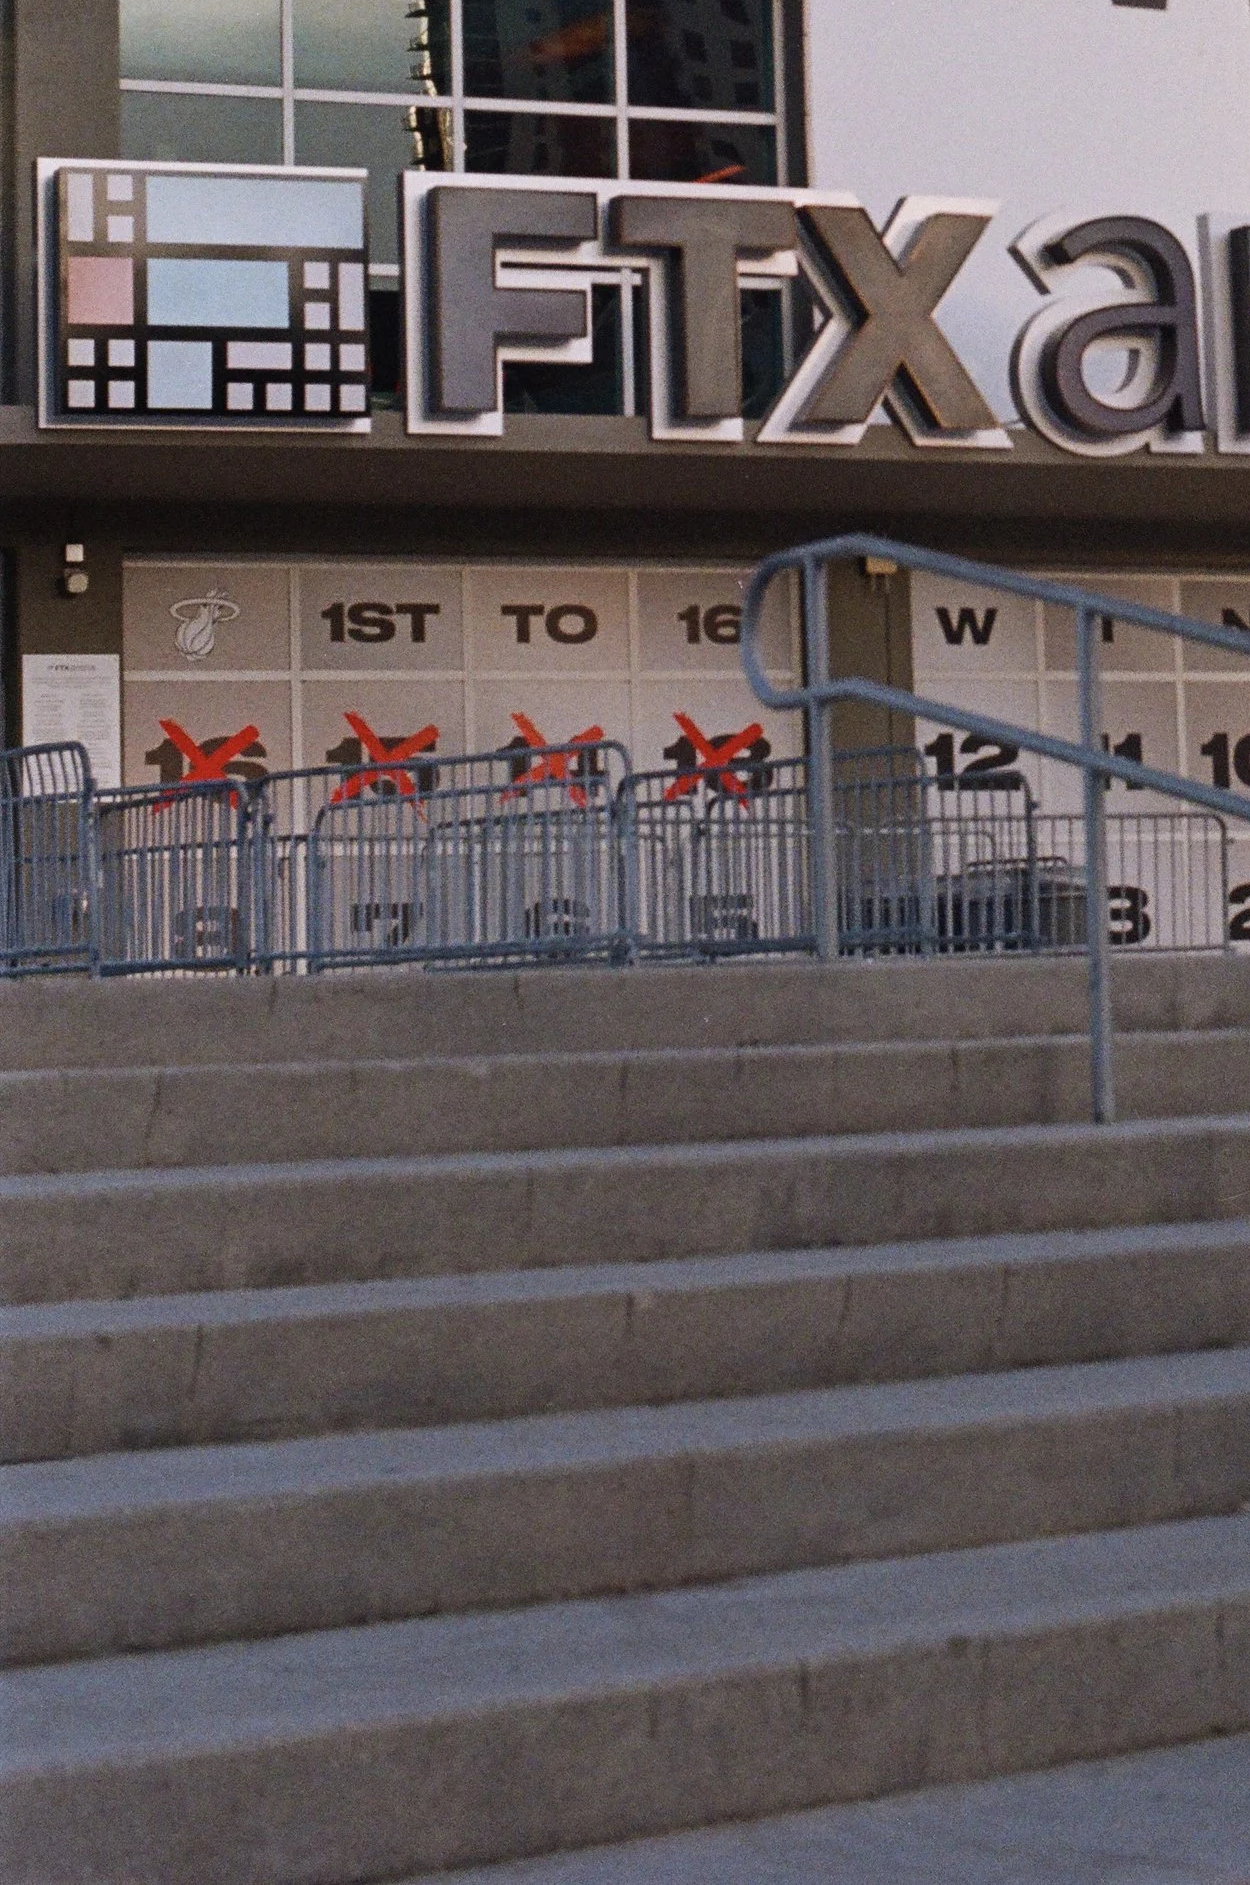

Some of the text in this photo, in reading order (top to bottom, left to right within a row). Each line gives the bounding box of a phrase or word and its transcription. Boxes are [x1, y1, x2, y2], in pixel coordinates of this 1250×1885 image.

[400, 169, 1014, 450] FTX
[321, 601, 441, 645] 1ST
[502, 603, 599, 645] TO
[677, 604, 742, 646] 16
[924, 732, 1022, 792] 12
